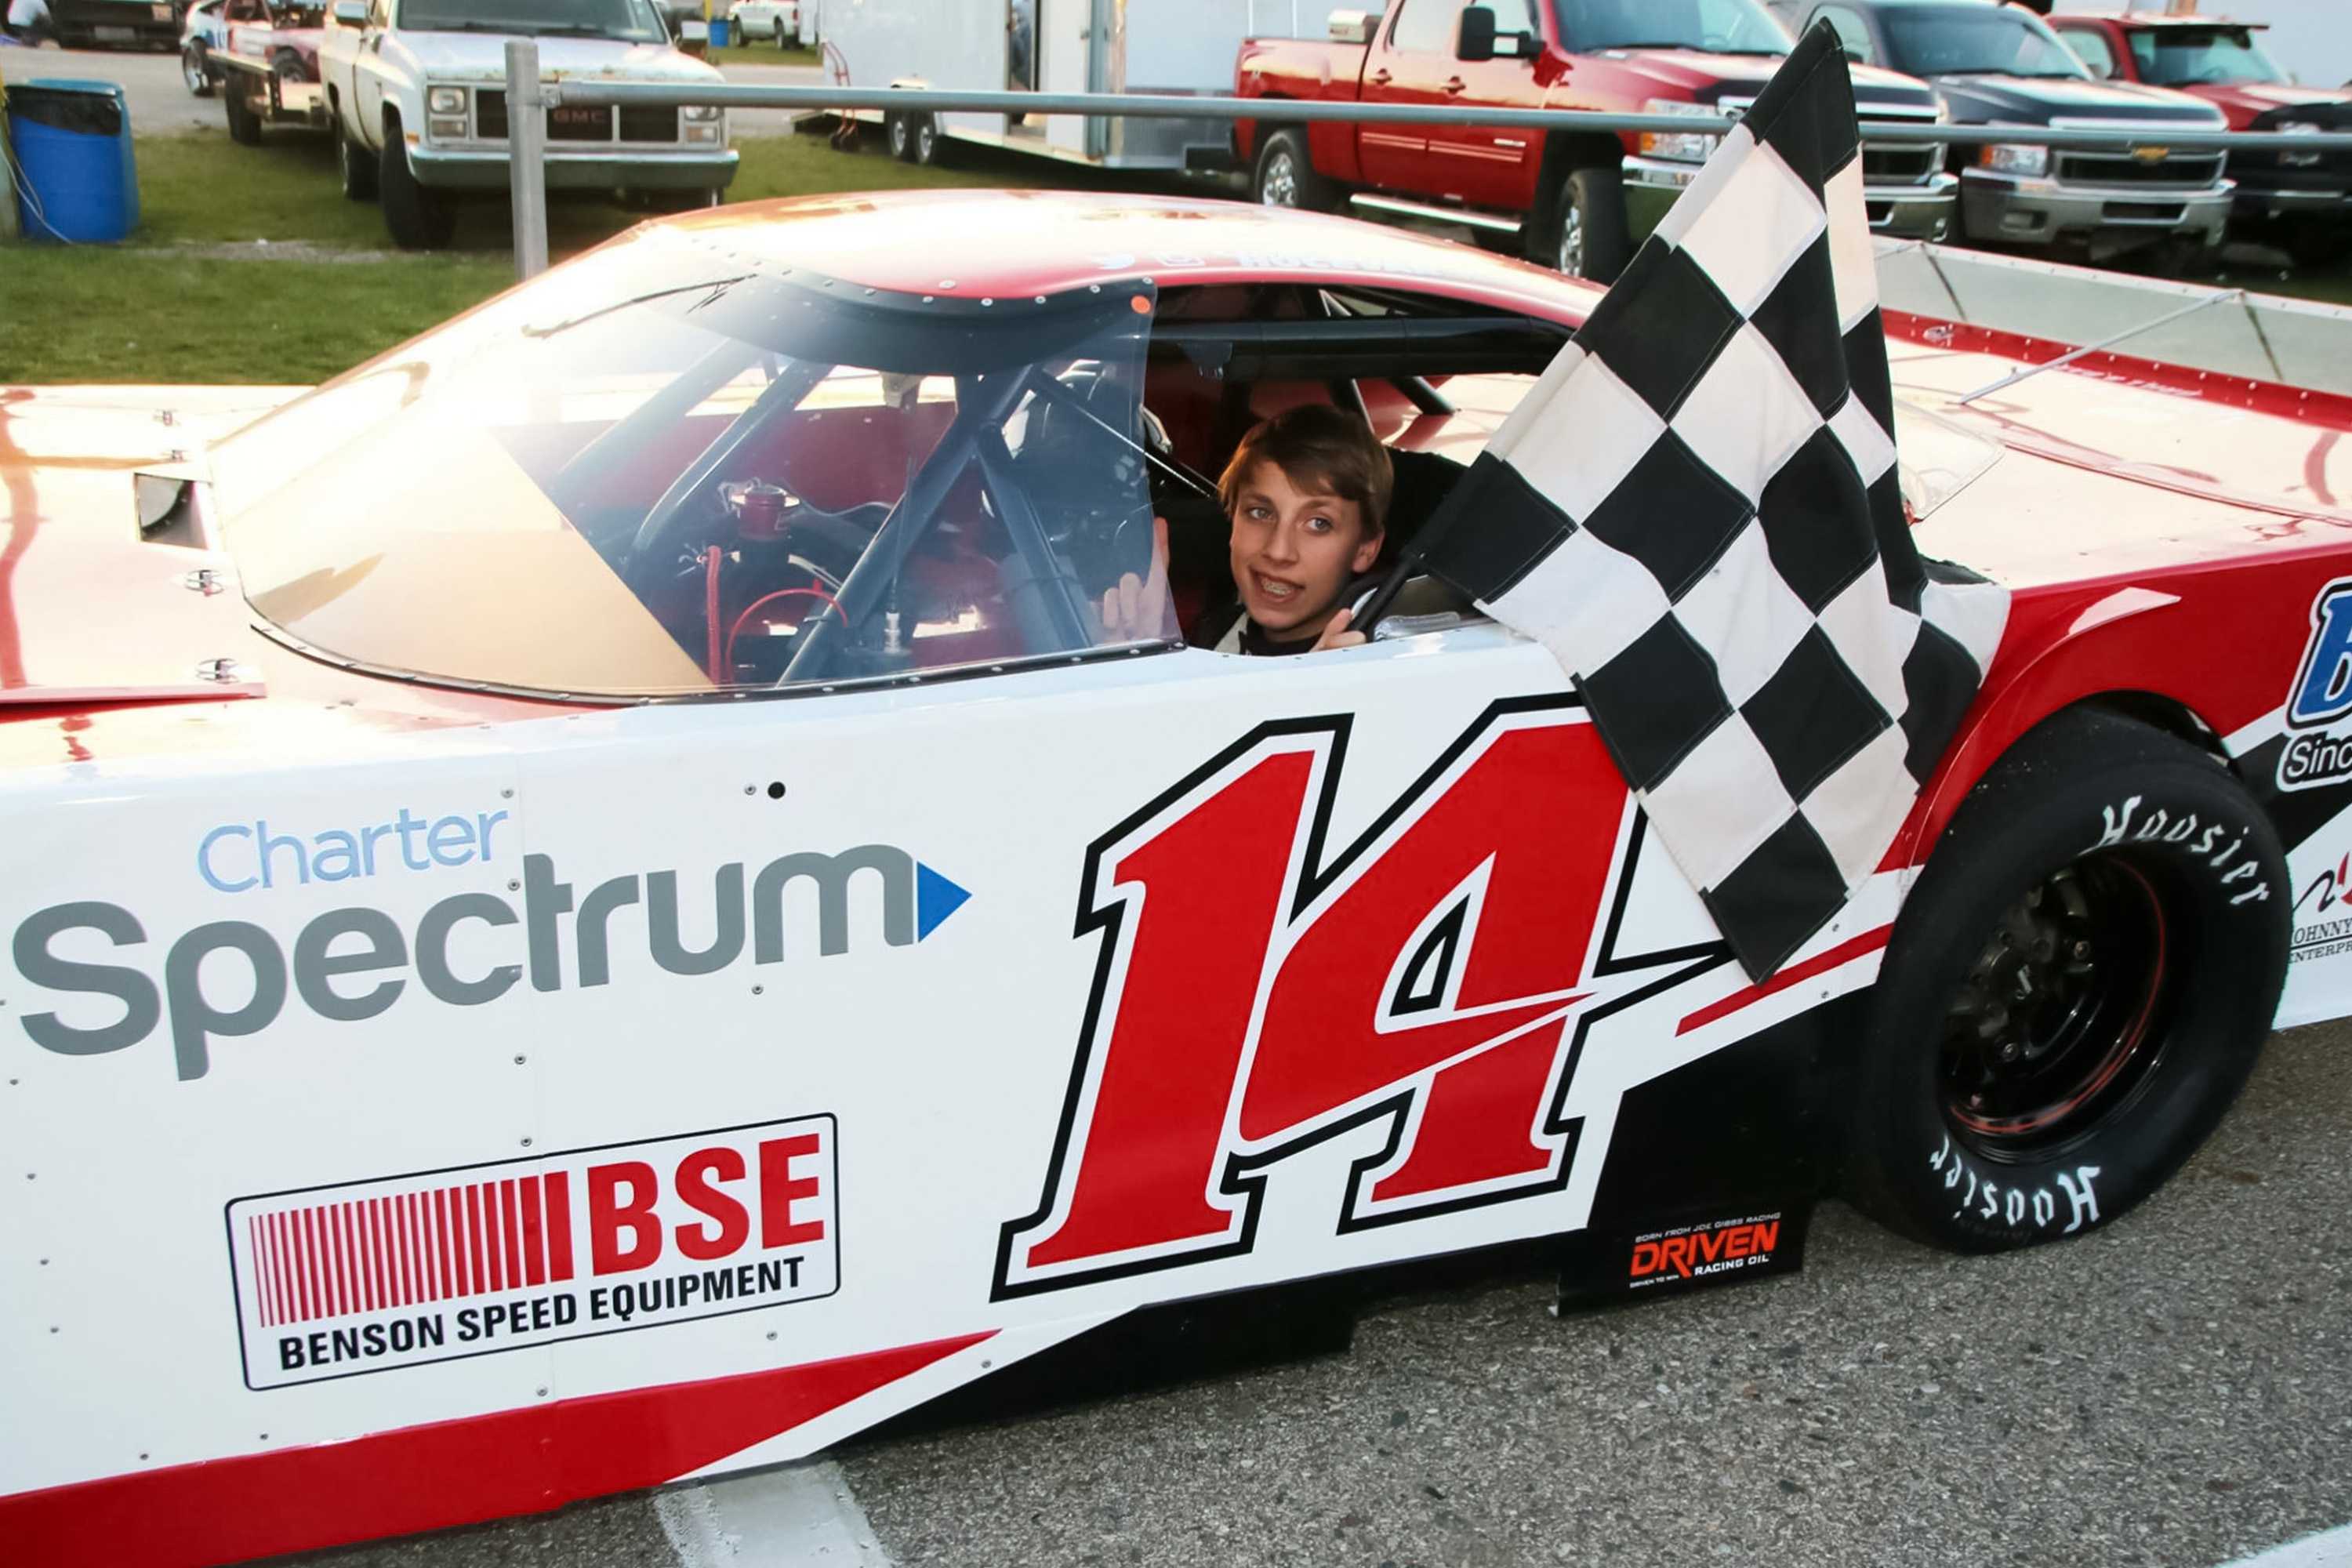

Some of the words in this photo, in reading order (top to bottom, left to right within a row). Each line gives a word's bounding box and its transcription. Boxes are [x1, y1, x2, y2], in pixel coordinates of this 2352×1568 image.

[554, 108, 607, 124] GMC
[196, 808, 508, 893] Charter
[2096, 795, 2270, 905] Hoosier
[13, 844, 914, 1080] Spectrum
[2293, 917, 2352, 944] OHNNY
[990, 693, 1729, 1303] 14
[587, 1133, 824, 1277] BSE
[1635, 1232, 1662, 1243] BORN
[1664, 1226, 1691, 1237] FROM
[1693, 1222, 1712, 1232] JOE
[1714, 1218, 1744, 1229] GIBBS
[1745, 1212, 1781, 1223] RACING
[1929, 1134, 2101, 1233] Hoosier
[1630, 1221, 1780, 1278] DRIVEN
[1694, 1258, 1744, 1276] RACING
[1748, 1254, 1769, 1265] OIL
[280, 1314, 445, 1370] BENSON
[457, 1293, 577, 1342] SPEED
[590, 1256, 805, 1322] EQUIPMENT
